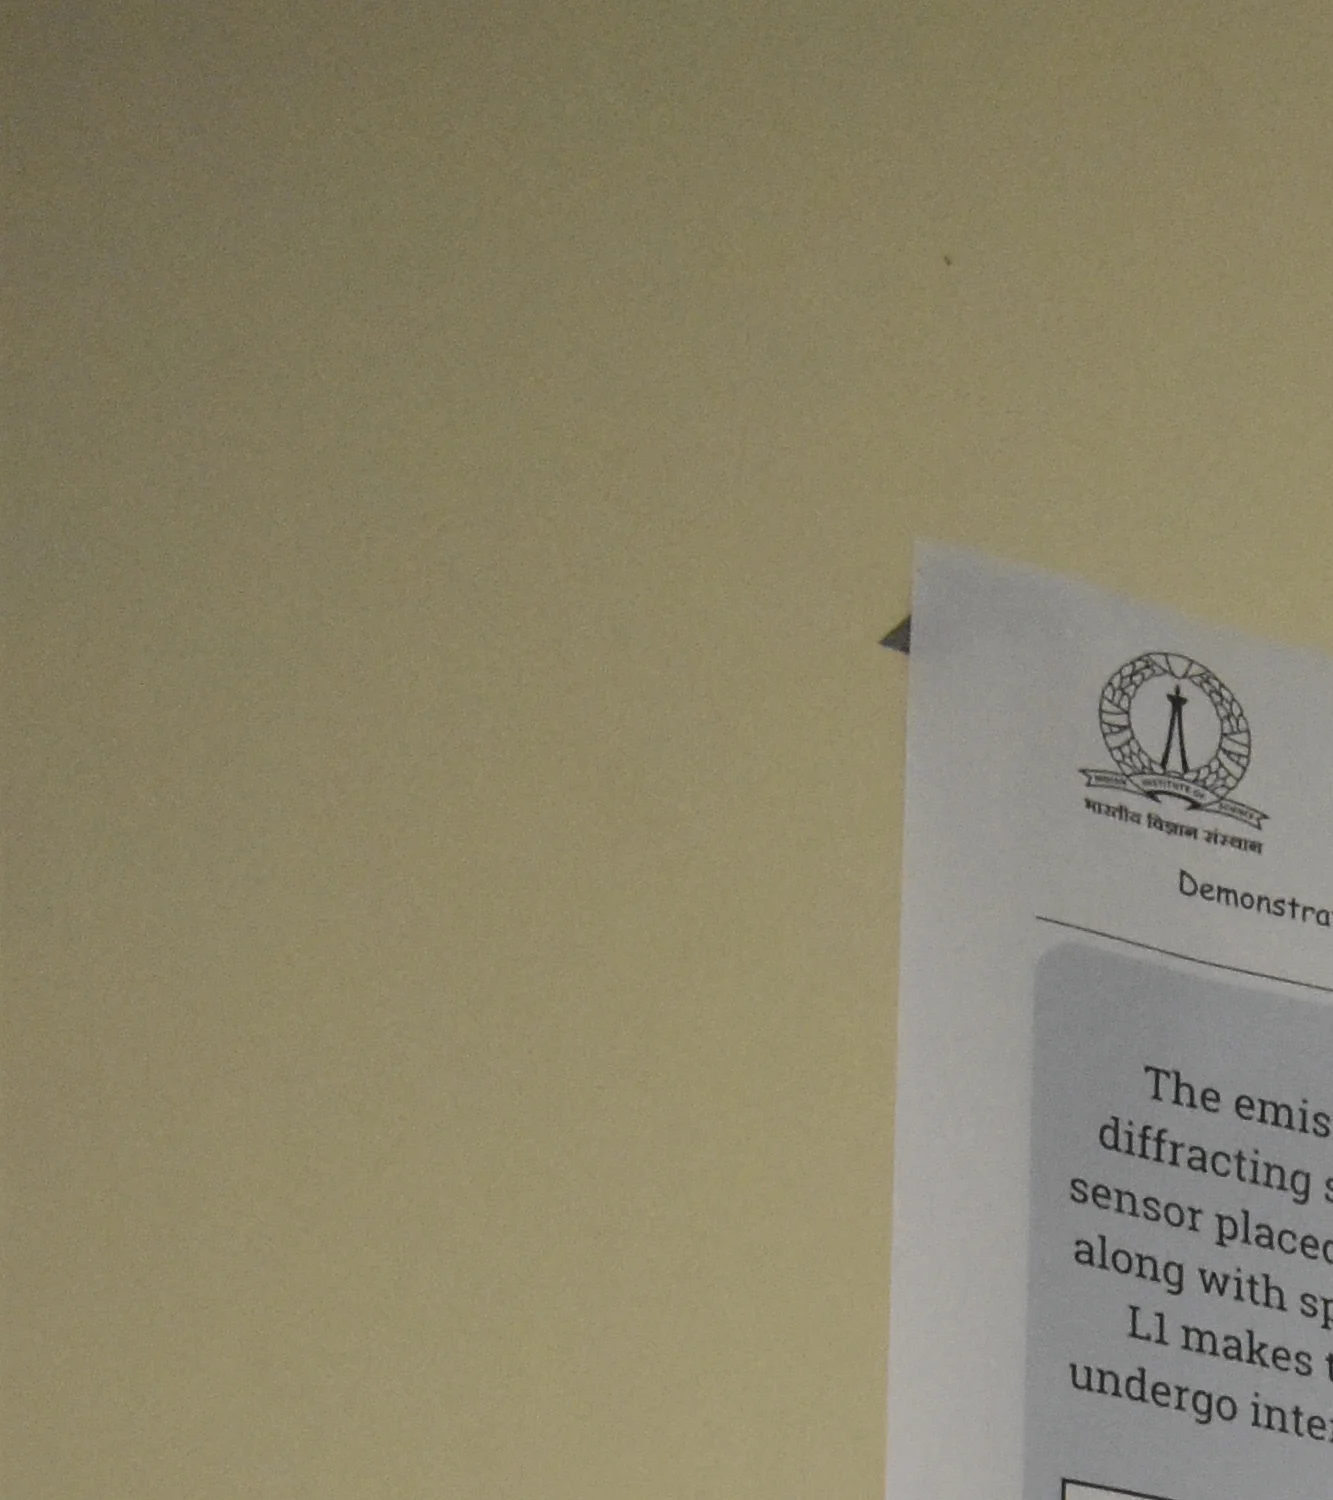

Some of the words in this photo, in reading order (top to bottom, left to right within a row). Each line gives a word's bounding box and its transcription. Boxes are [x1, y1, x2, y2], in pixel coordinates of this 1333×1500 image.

[1084, 797, 1142, 825] भारतीय
[1146, 812, 1198, 840] विज्ञान
[1203, 828, 1263, 855] संस्थान
[1144, 1064, 1221, 1114] The
[1070, 1178, 1204, 1233] sensor
[1069, 1362, 1238, 1425] undergo
